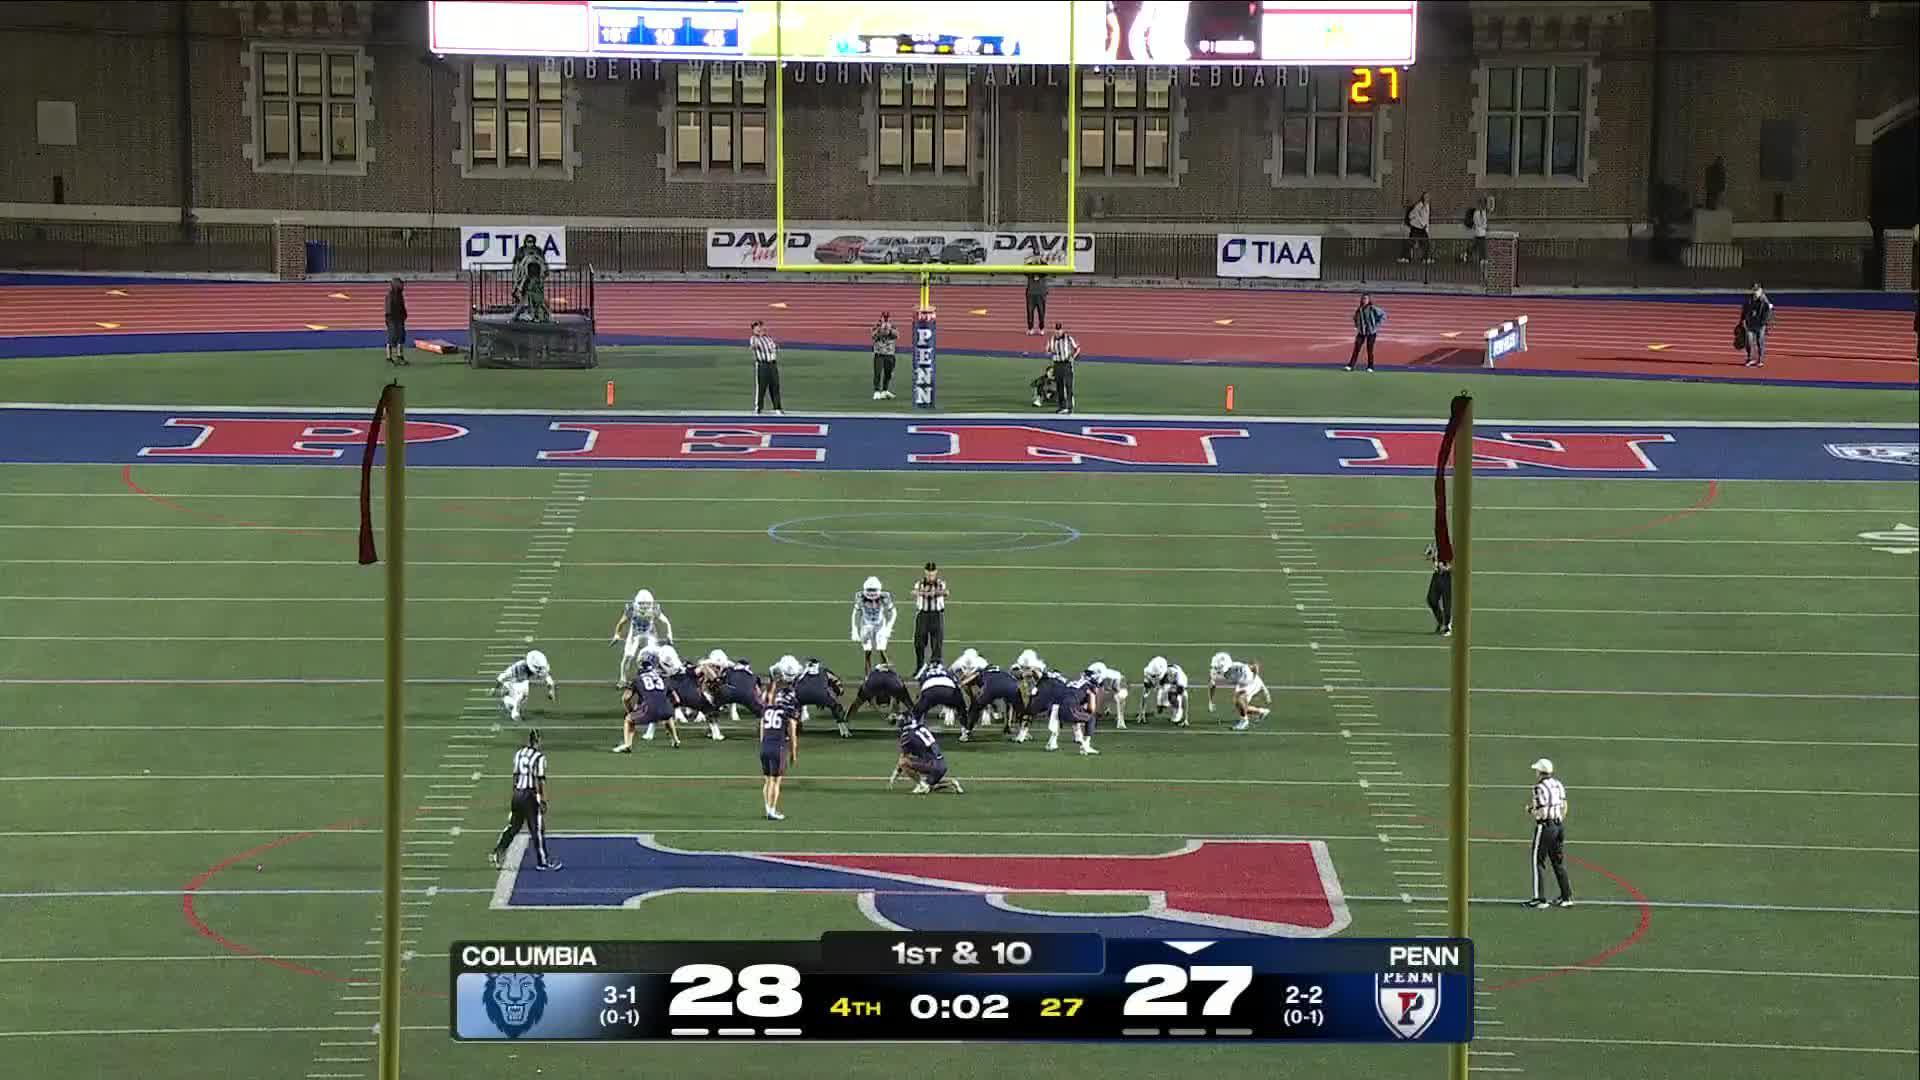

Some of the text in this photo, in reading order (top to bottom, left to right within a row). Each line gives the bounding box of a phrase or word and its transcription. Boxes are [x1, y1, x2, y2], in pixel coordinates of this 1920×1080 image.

[544, 57, 663, 81] ROBERT
[794, 62, 938, 85] JOHNSON
[966, 64, 1060, 87] FAMIL
[1351, 67, 1399, 102] 27
[495, 234, 560, 257] TIA
[1251, 241, 1316, 264] TIAA
[915, 328, 934, 404] PENN
[137, 417, 1676, 472] PENN
[764, 708, 784, 729] 96
